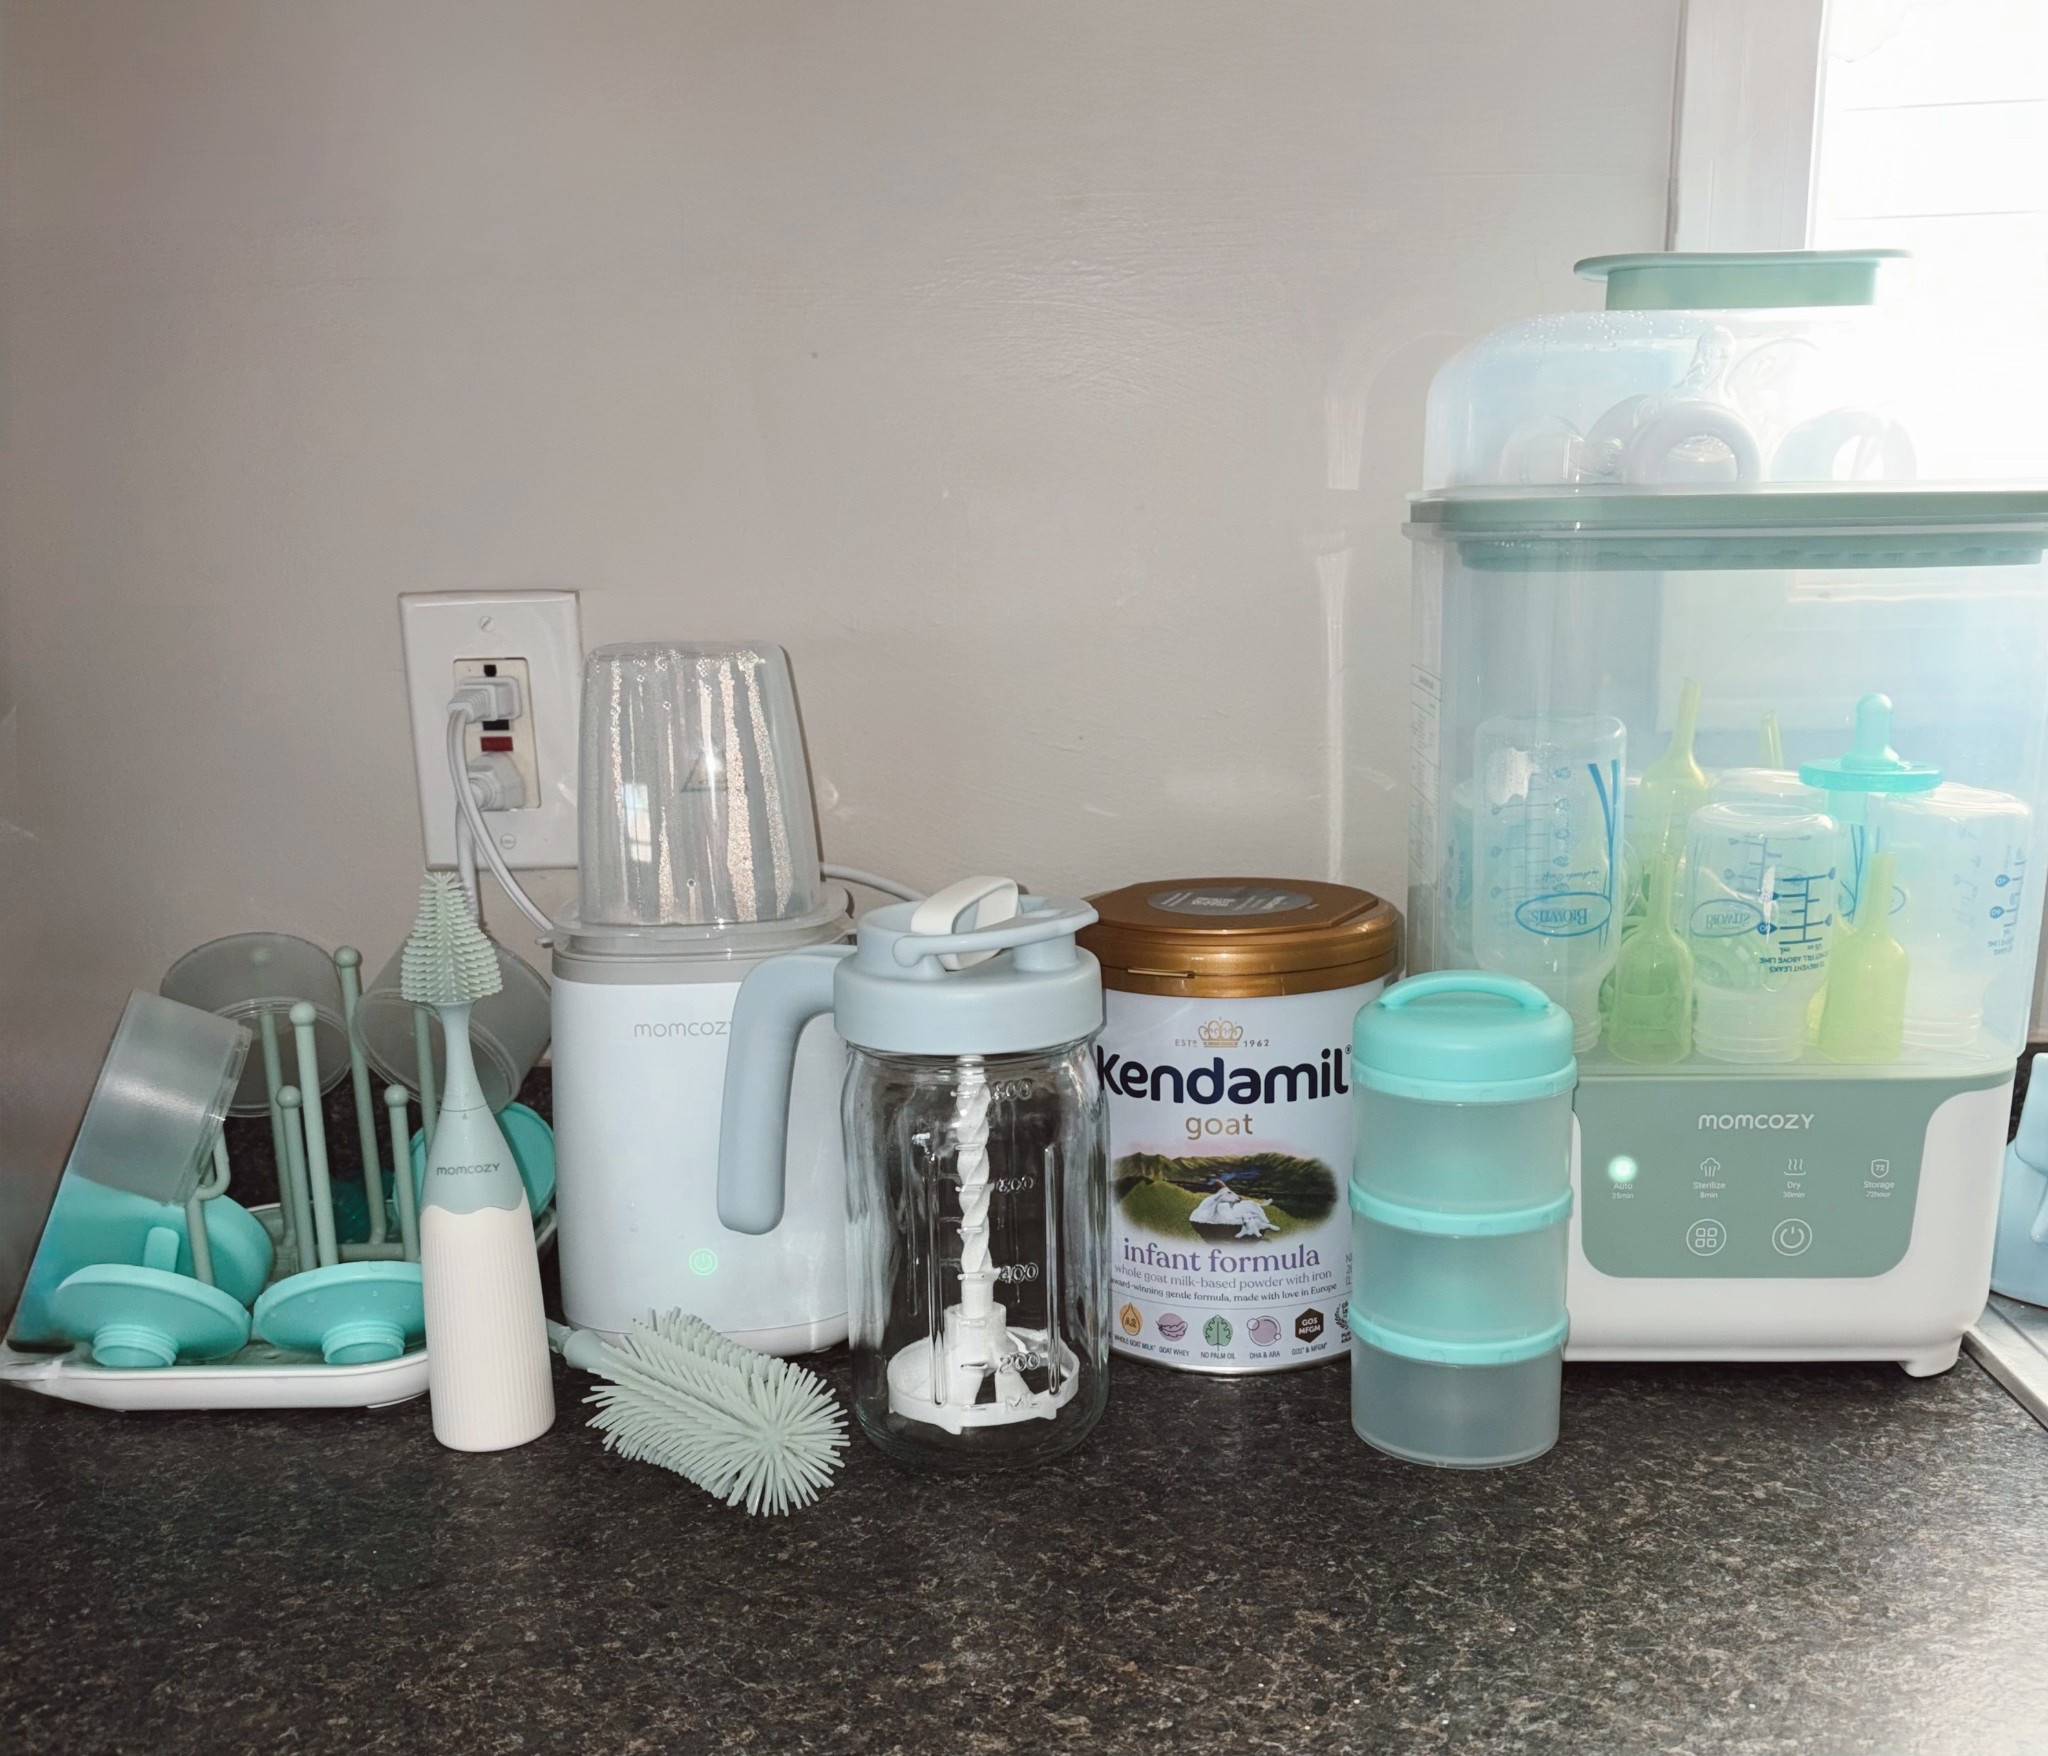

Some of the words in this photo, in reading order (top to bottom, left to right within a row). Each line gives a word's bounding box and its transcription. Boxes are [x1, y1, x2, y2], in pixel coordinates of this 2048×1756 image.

[1243, 1039, 1269, 1047] 1962
[1185, 1114, 1253, 1140] goat
[1613, 1182, 1633, 1190] Auto
[1693, 1181, 1726, 1190] Sterilize
[1787, 1181, 1800, 1191] Dry
[1864, 1180, 1895, 1190] Storage
[1783, 1191, 1805, 1199] 30min
[1124, 1238, 1201, 1271] infant
[1208, 1244, 1320, 1273] formula
[1114, 1263, 1141, 1278] whole
[1144, 1272, 1167, 1283] goat
[1170, 1276, 1236, 1288] milk-based
[1239, 1277, 1283, 1291] powder
[1286, 1272, 1309, 1286] with
[1312, 1270, 1332, 1281] iron
[1165, 1289, 1191, 1299] gentle
[1194, 1291, 1231, 1302] formula,
[1234, 1292, 1259, 1301] made
[1261, 1290, 1280, 1300] with
[1282, 1289, 1299, 1298] love
[1301, 1287, 1309, 1296] in
[1311, 1284, 1337, 1295] Europe
[1302, 1317, 1318, 1326] GOS
[1299, 1325, 1320, 1334] MFGM
